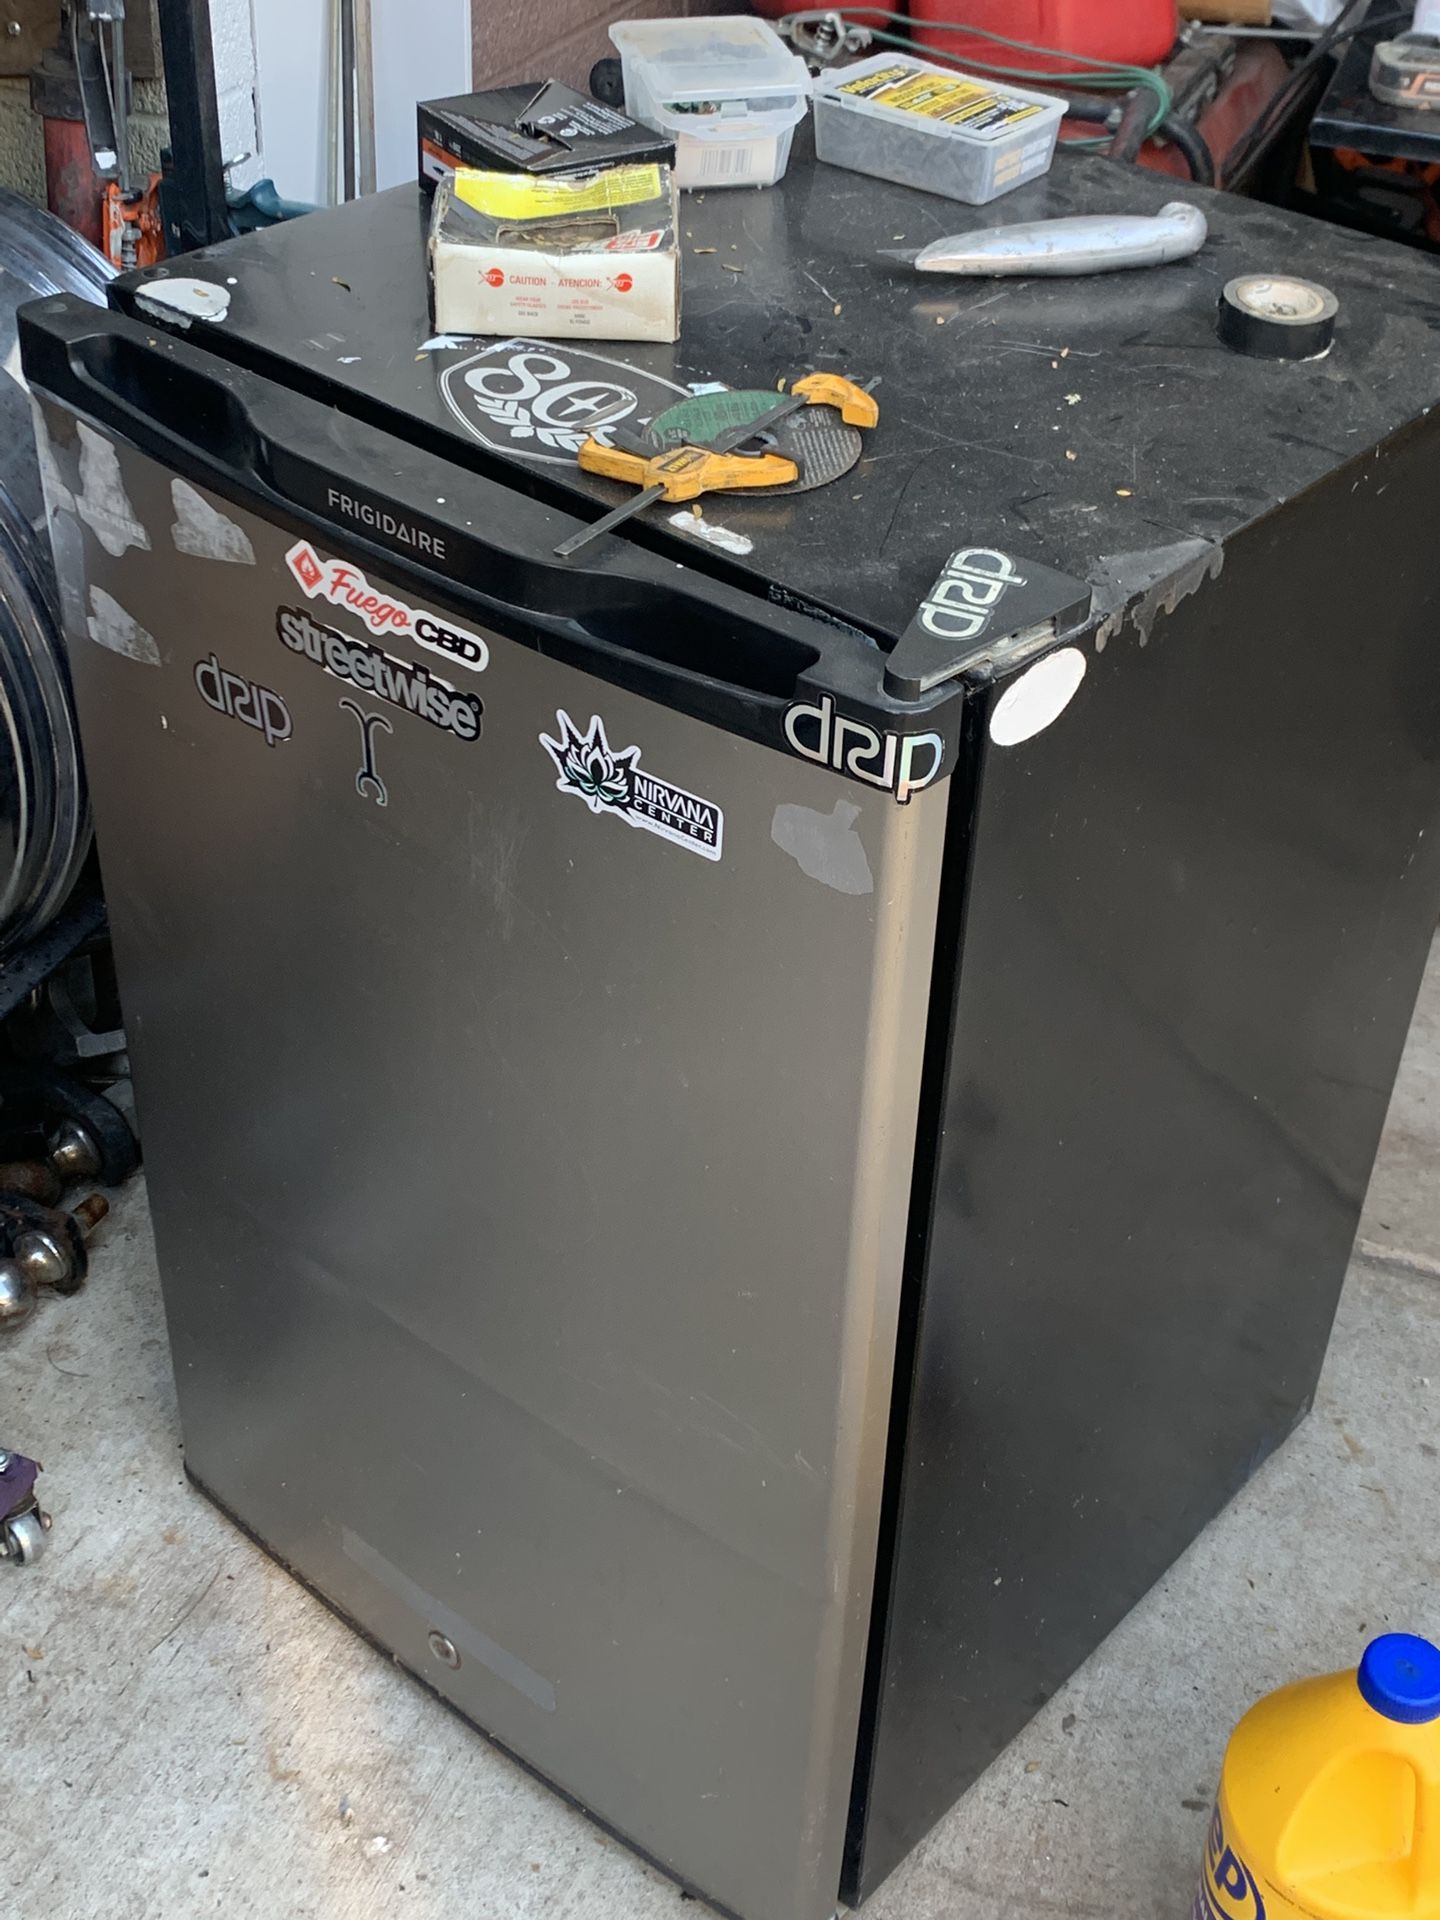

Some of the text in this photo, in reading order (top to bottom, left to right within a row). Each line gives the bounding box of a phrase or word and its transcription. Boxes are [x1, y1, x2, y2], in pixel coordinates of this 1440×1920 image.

[509, 275, 547, 287] CAUTION
[327, 488, 447, 560] FRIGIDAIRE
[330, 567, 481, 663] Fuego CBD
[633, 799, 713, 843] CENTER
[634, 775, 714, 830] NIRVANA
